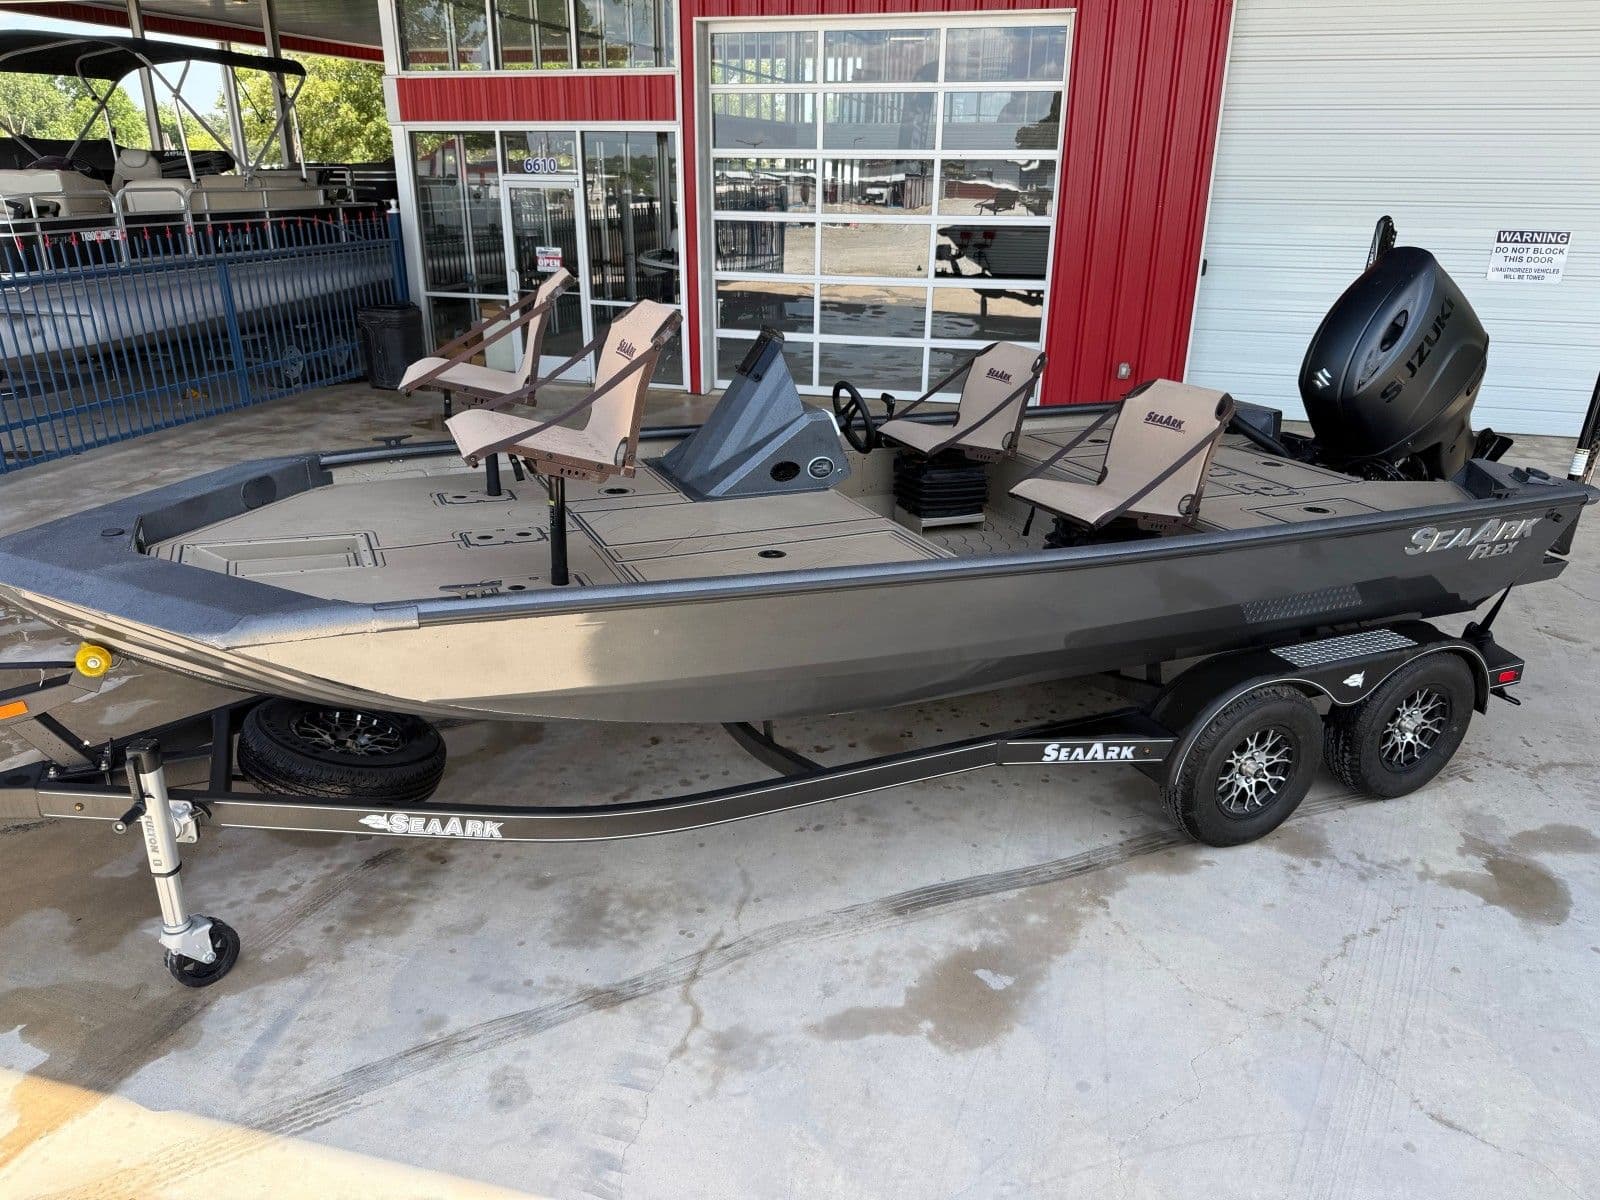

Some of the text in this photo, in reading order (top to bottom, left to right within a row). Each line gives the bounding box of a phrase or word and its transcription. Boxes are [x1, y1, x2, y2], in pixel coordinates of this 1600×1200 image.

[524, 158, 557, 173] 6610
[1500, 231, 1568, 243] WARNING
[1495, 246, 1509, 254] DO
[1532, 247, 1565, 255] BLOCK
[537, 258, 561, 267] OPEN
[1503, 255, 1554, 264] THIS DOOR
[1380, 295, 1456, 404] SUZUKI
[1467, 541, 1519, 561] FLEX
